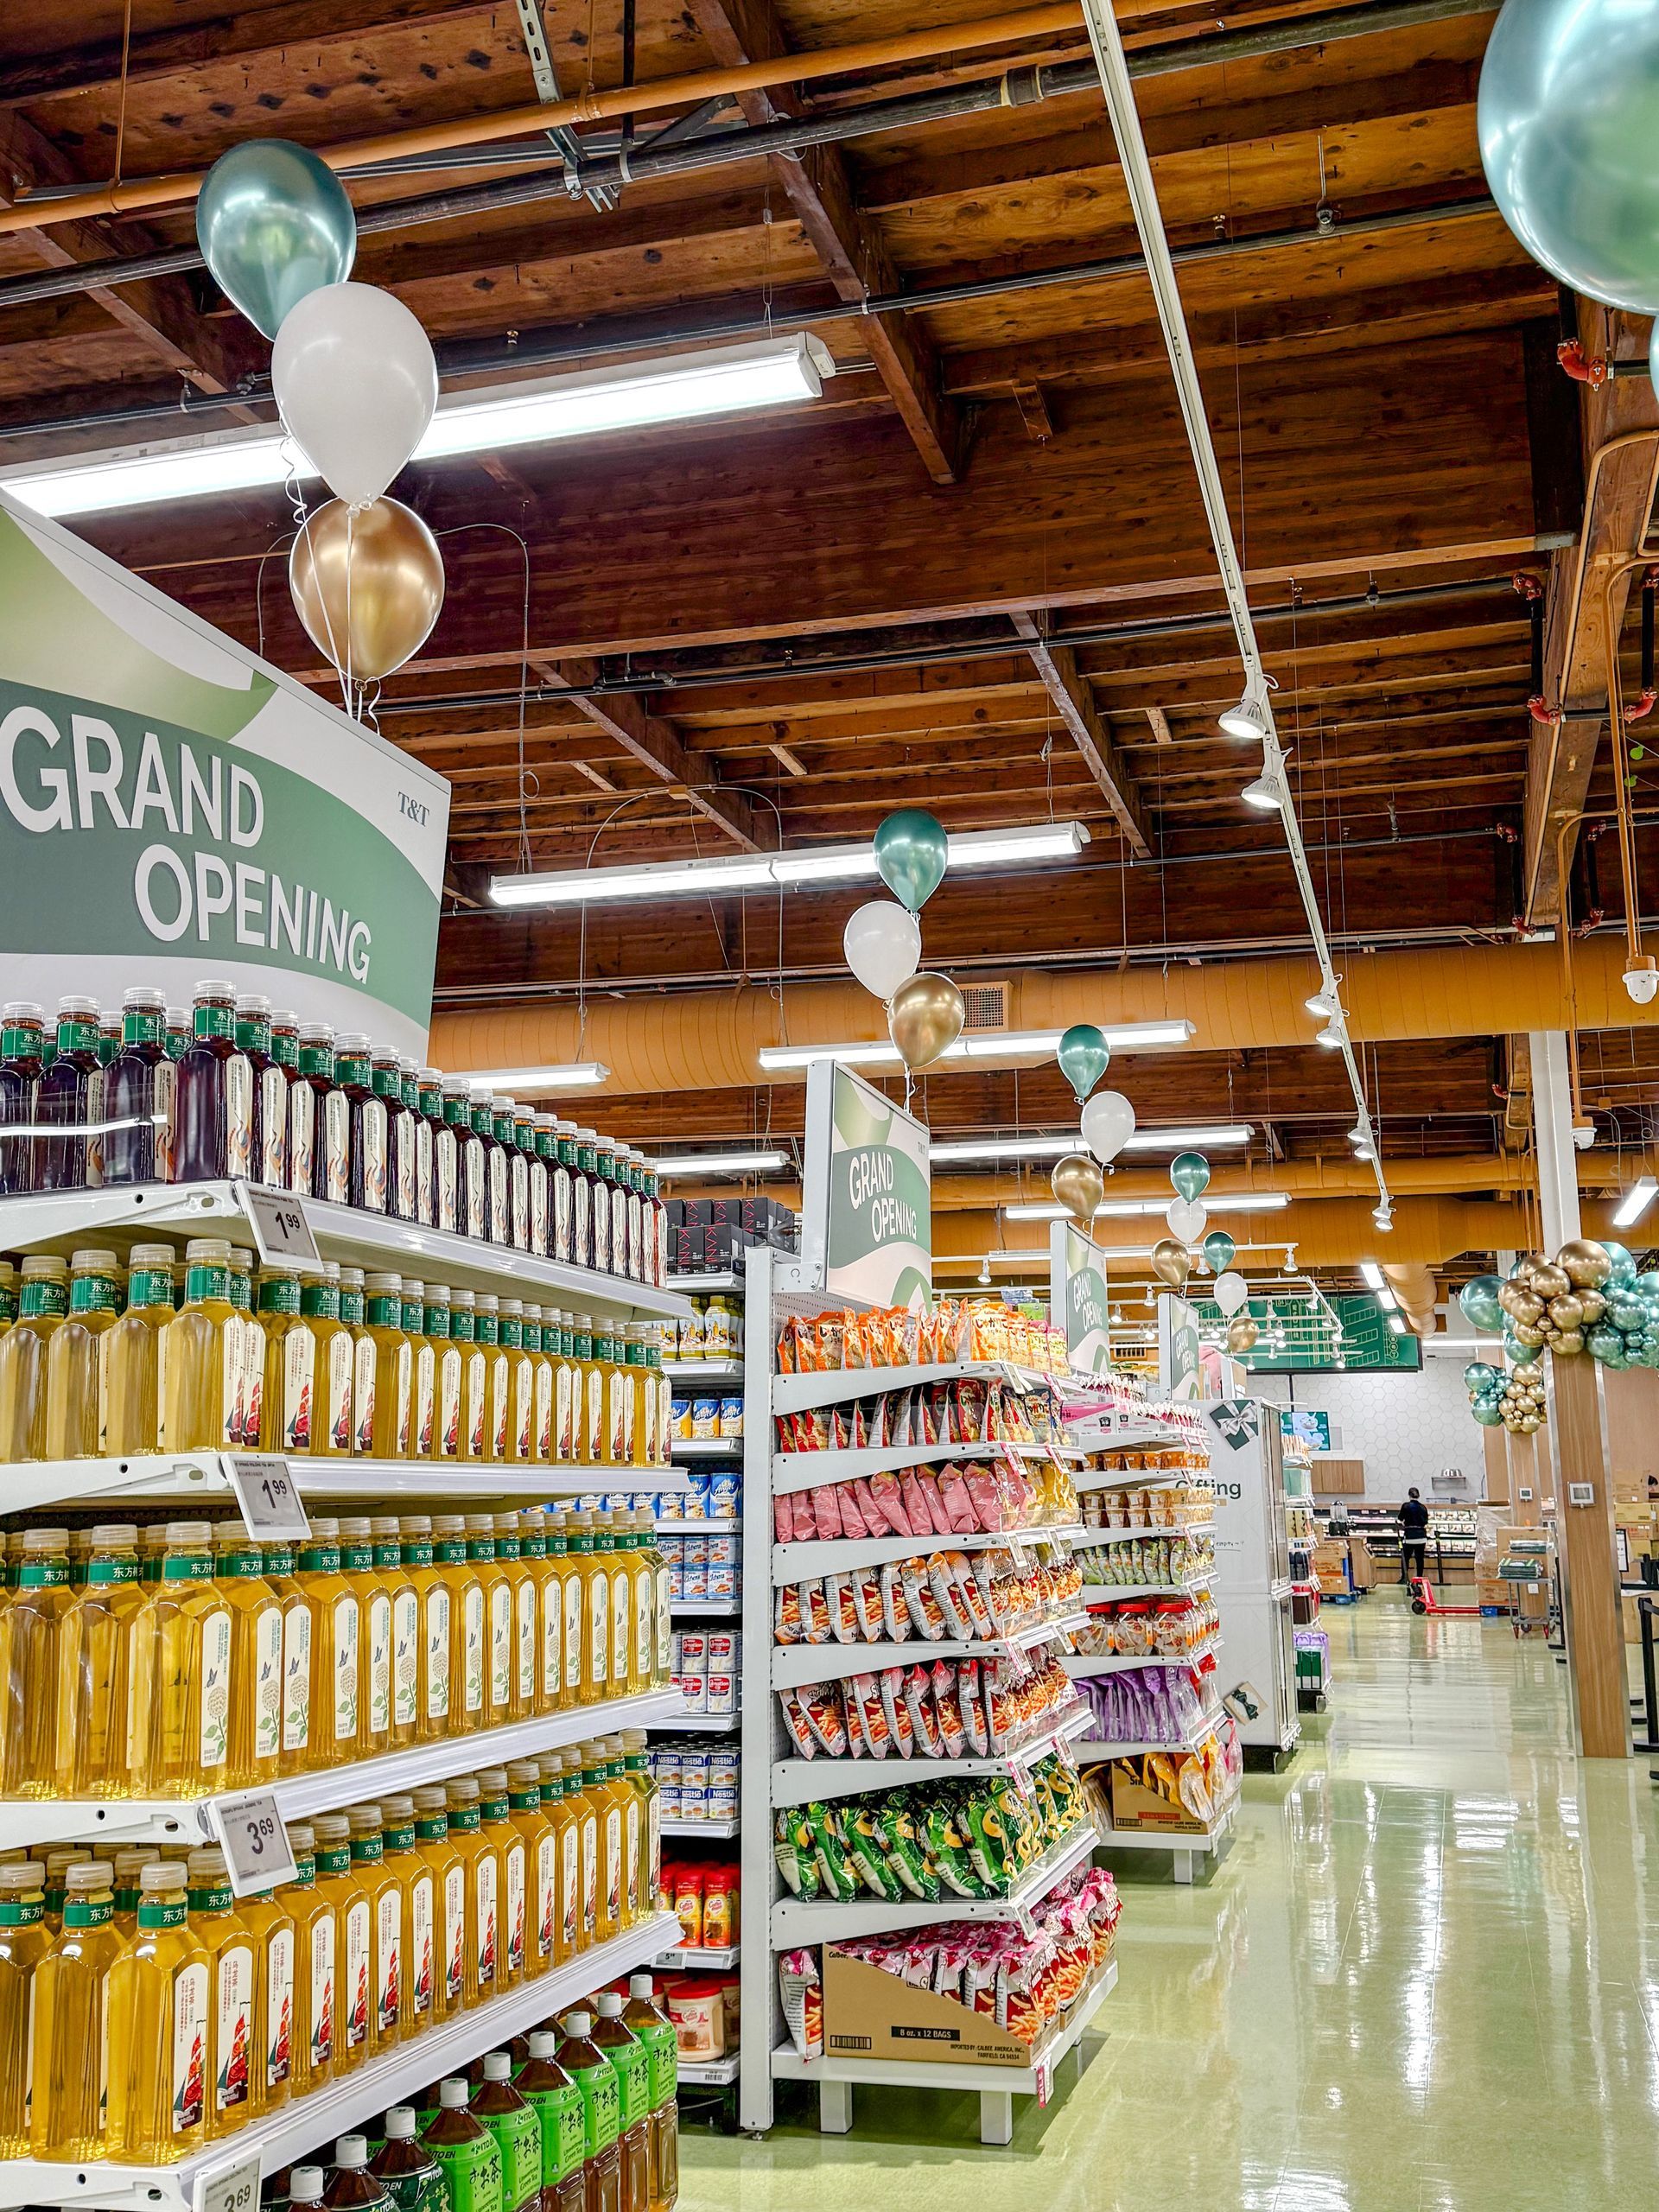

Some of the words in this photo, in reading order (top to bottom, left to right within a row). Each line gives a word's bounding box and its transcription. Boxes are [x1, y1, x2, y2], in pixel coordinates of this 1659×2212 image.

[0, 706, 264, 848] GRAND
[397, 791, 430, 827] T&T
[135, 843, 372, 985] OPENING
[849, 1152, 893, 1210] GRAND
[872, 1198, 917, 1243] OPENING
[1074, 1273, 1091, 1313] GRAND
[1083, 1300, 1103, 1332] OPENING
[933, 2031, 951, 2039] BAGS
[443, 2150, 456, 2158] EN
[389, 2181, 402, 2190] EN
